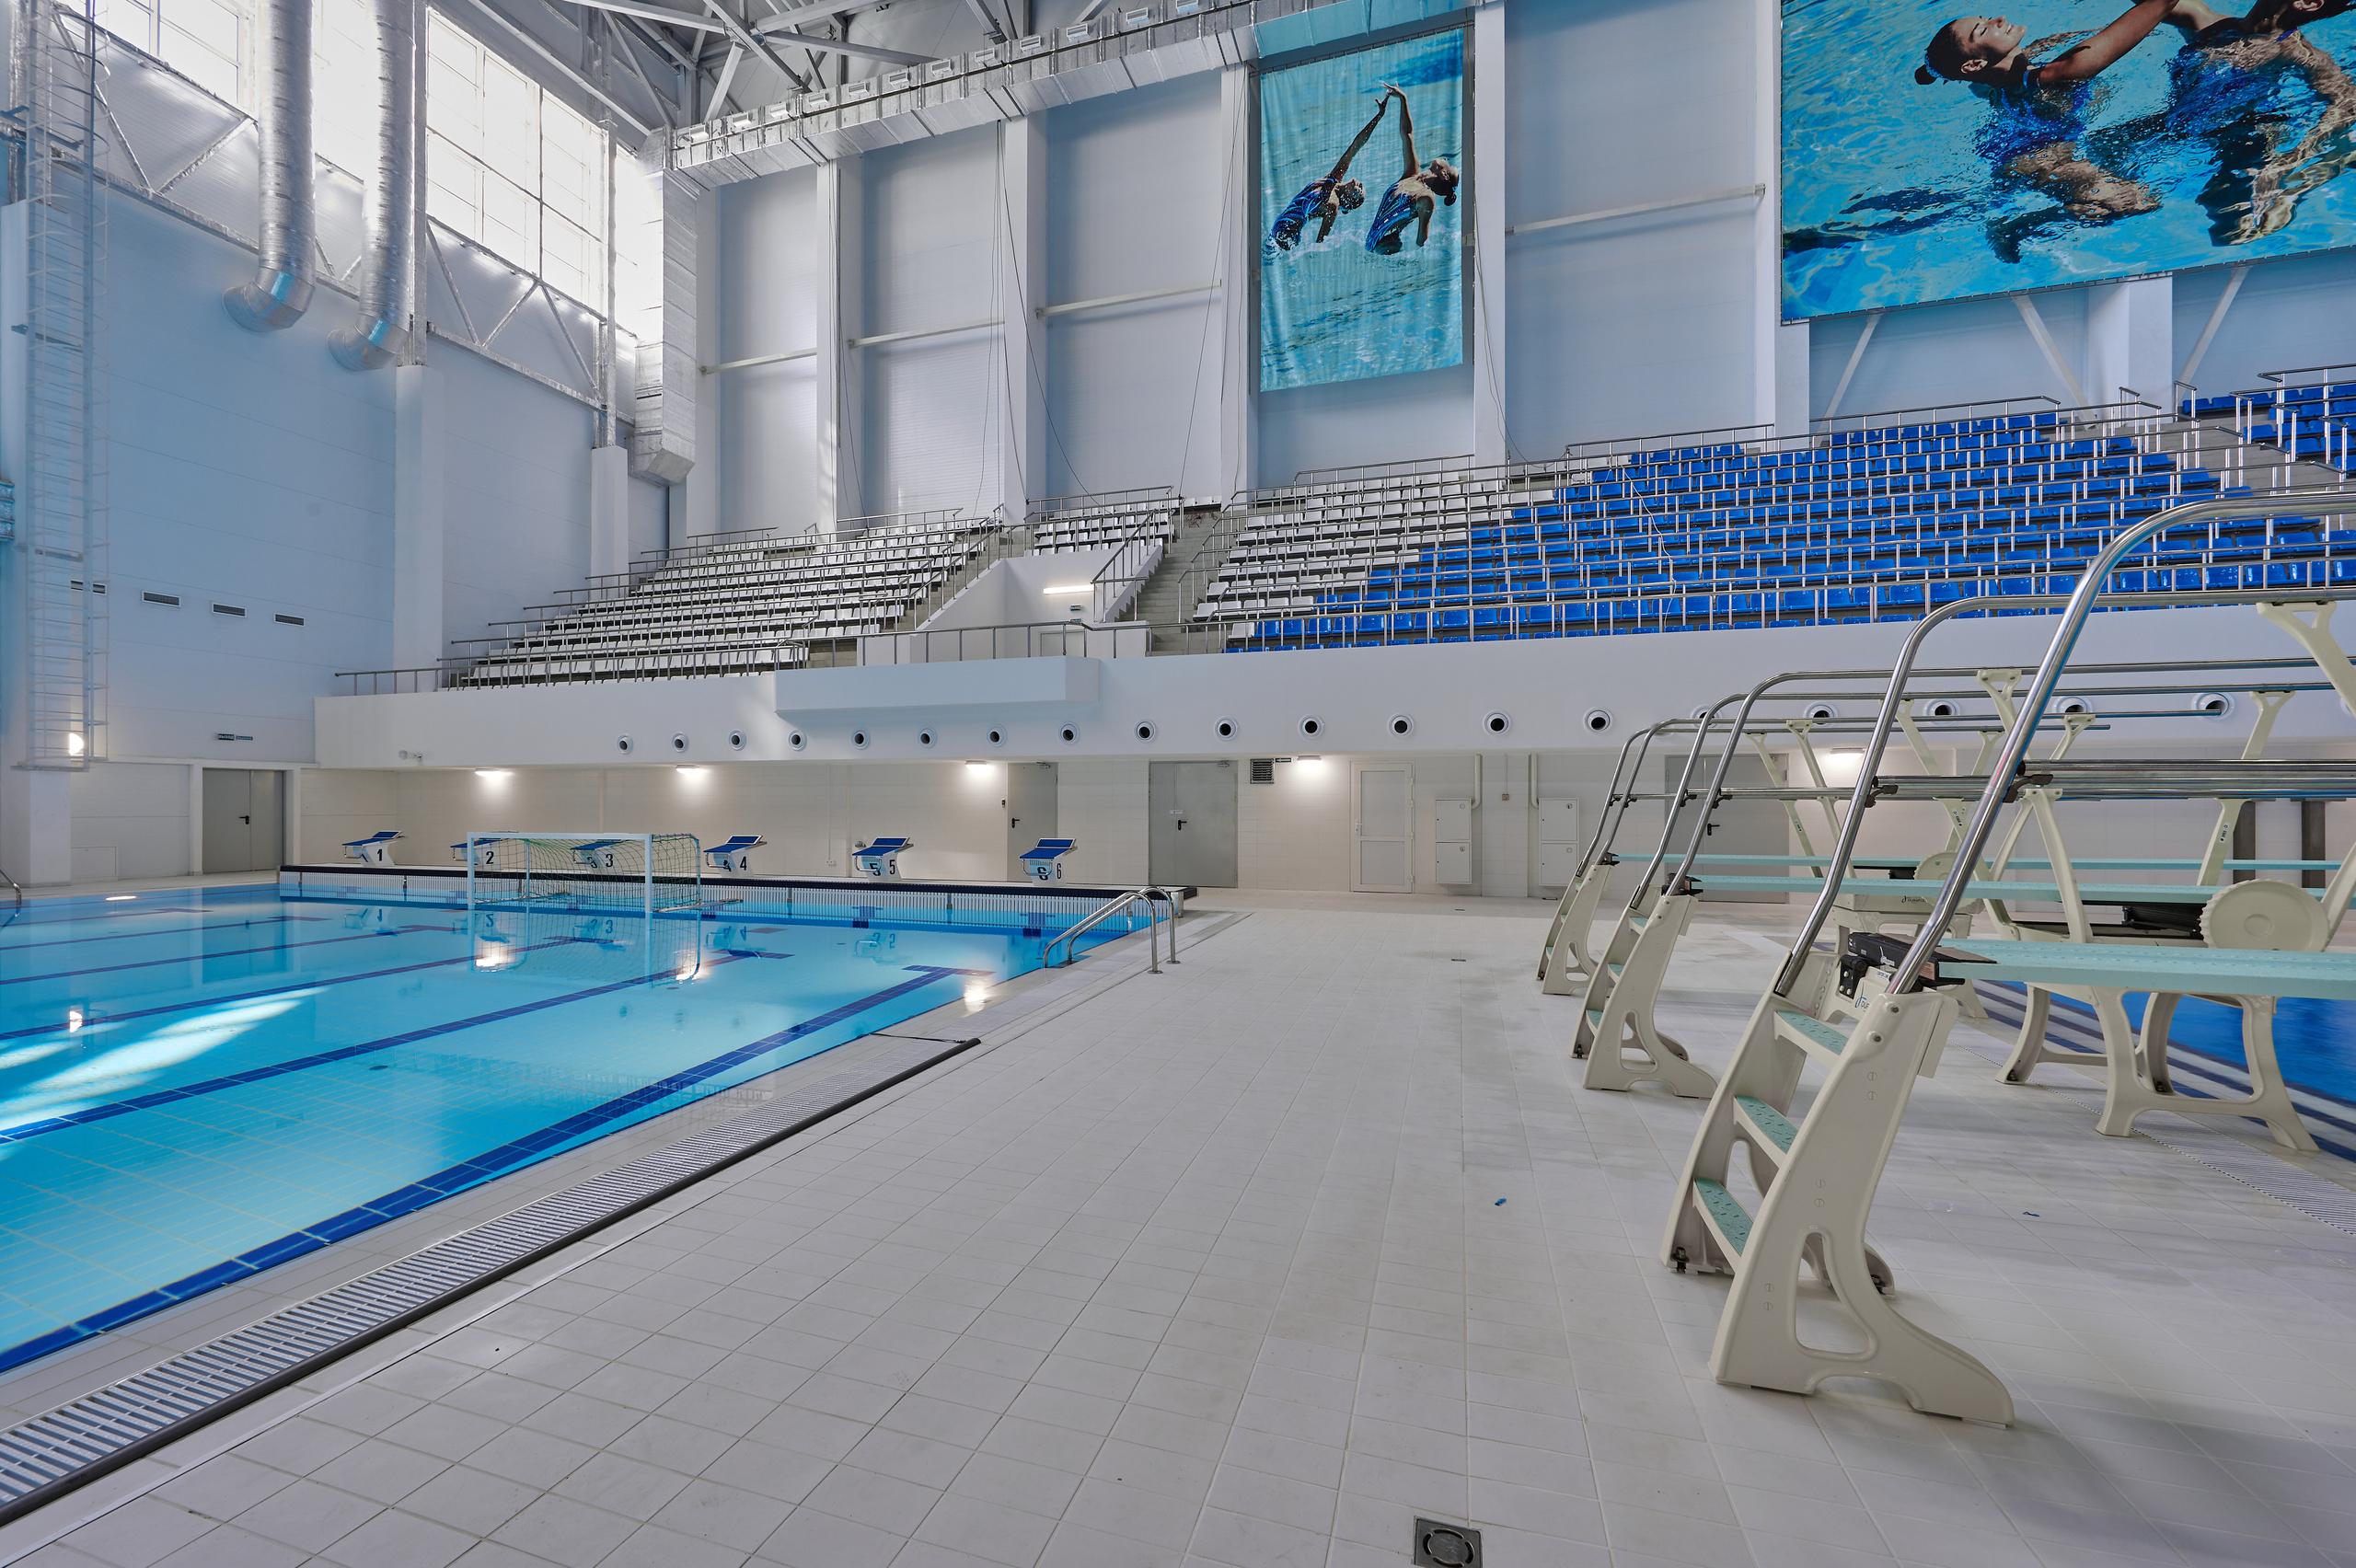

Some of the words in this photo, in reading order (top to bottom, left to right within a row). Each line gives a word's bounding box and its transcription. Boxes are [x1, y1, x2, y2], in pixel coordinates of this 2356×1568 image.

[377, 848, 383, 861] 1
[486, 850, 494, 864] 2
[606, 853, 614, 867] 3
[739, 856, 747, 870] 4
[889, 859, 895, 875] 5
[1057, 862, 1062, 880] 6
